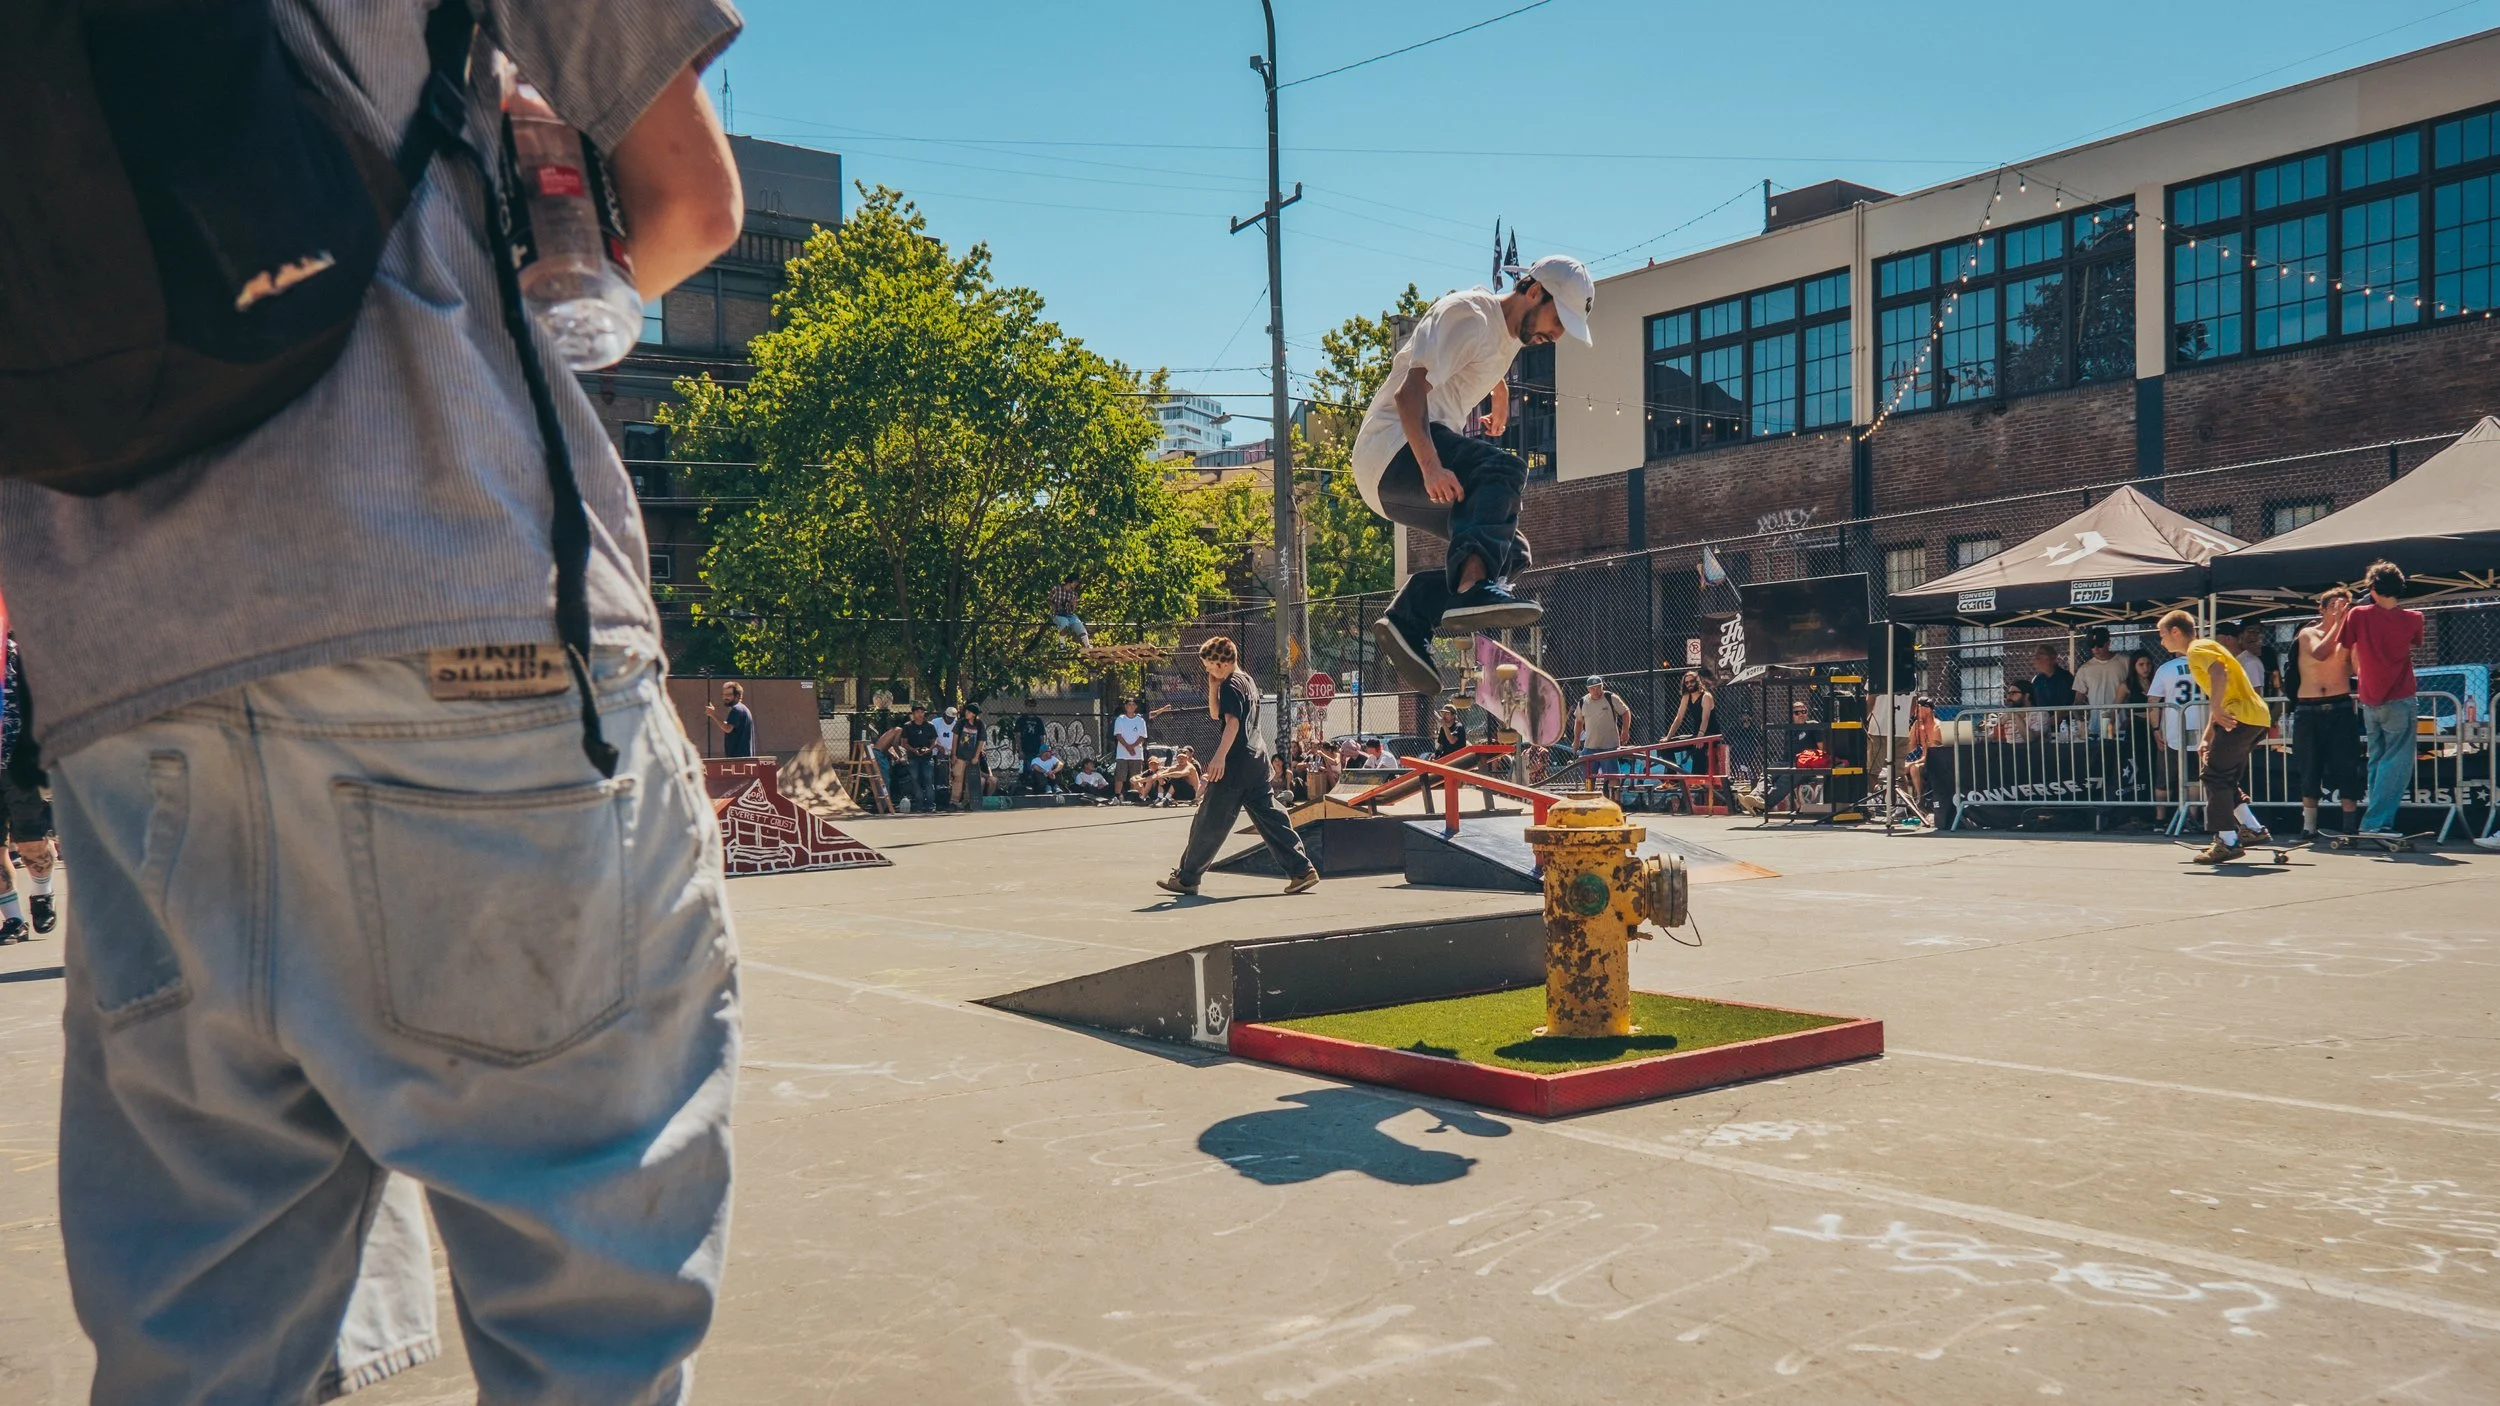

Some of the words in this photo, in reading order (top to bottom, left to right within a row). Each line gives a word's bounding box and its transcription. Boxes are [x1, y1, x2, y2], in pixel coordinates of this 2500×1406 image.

[2073, 581, 2111, 589] CONVERSE
[1960, 591, 1994, 600] CONVERSE
[1308, 684, 1333, 697] STOP
[721, 763, 757, 775] HUT
[1953, 780, 2082, 808] CONVERSE
[730, 808, 769, 823] EVERETT
[770, 818, 795, 830] CRUST
